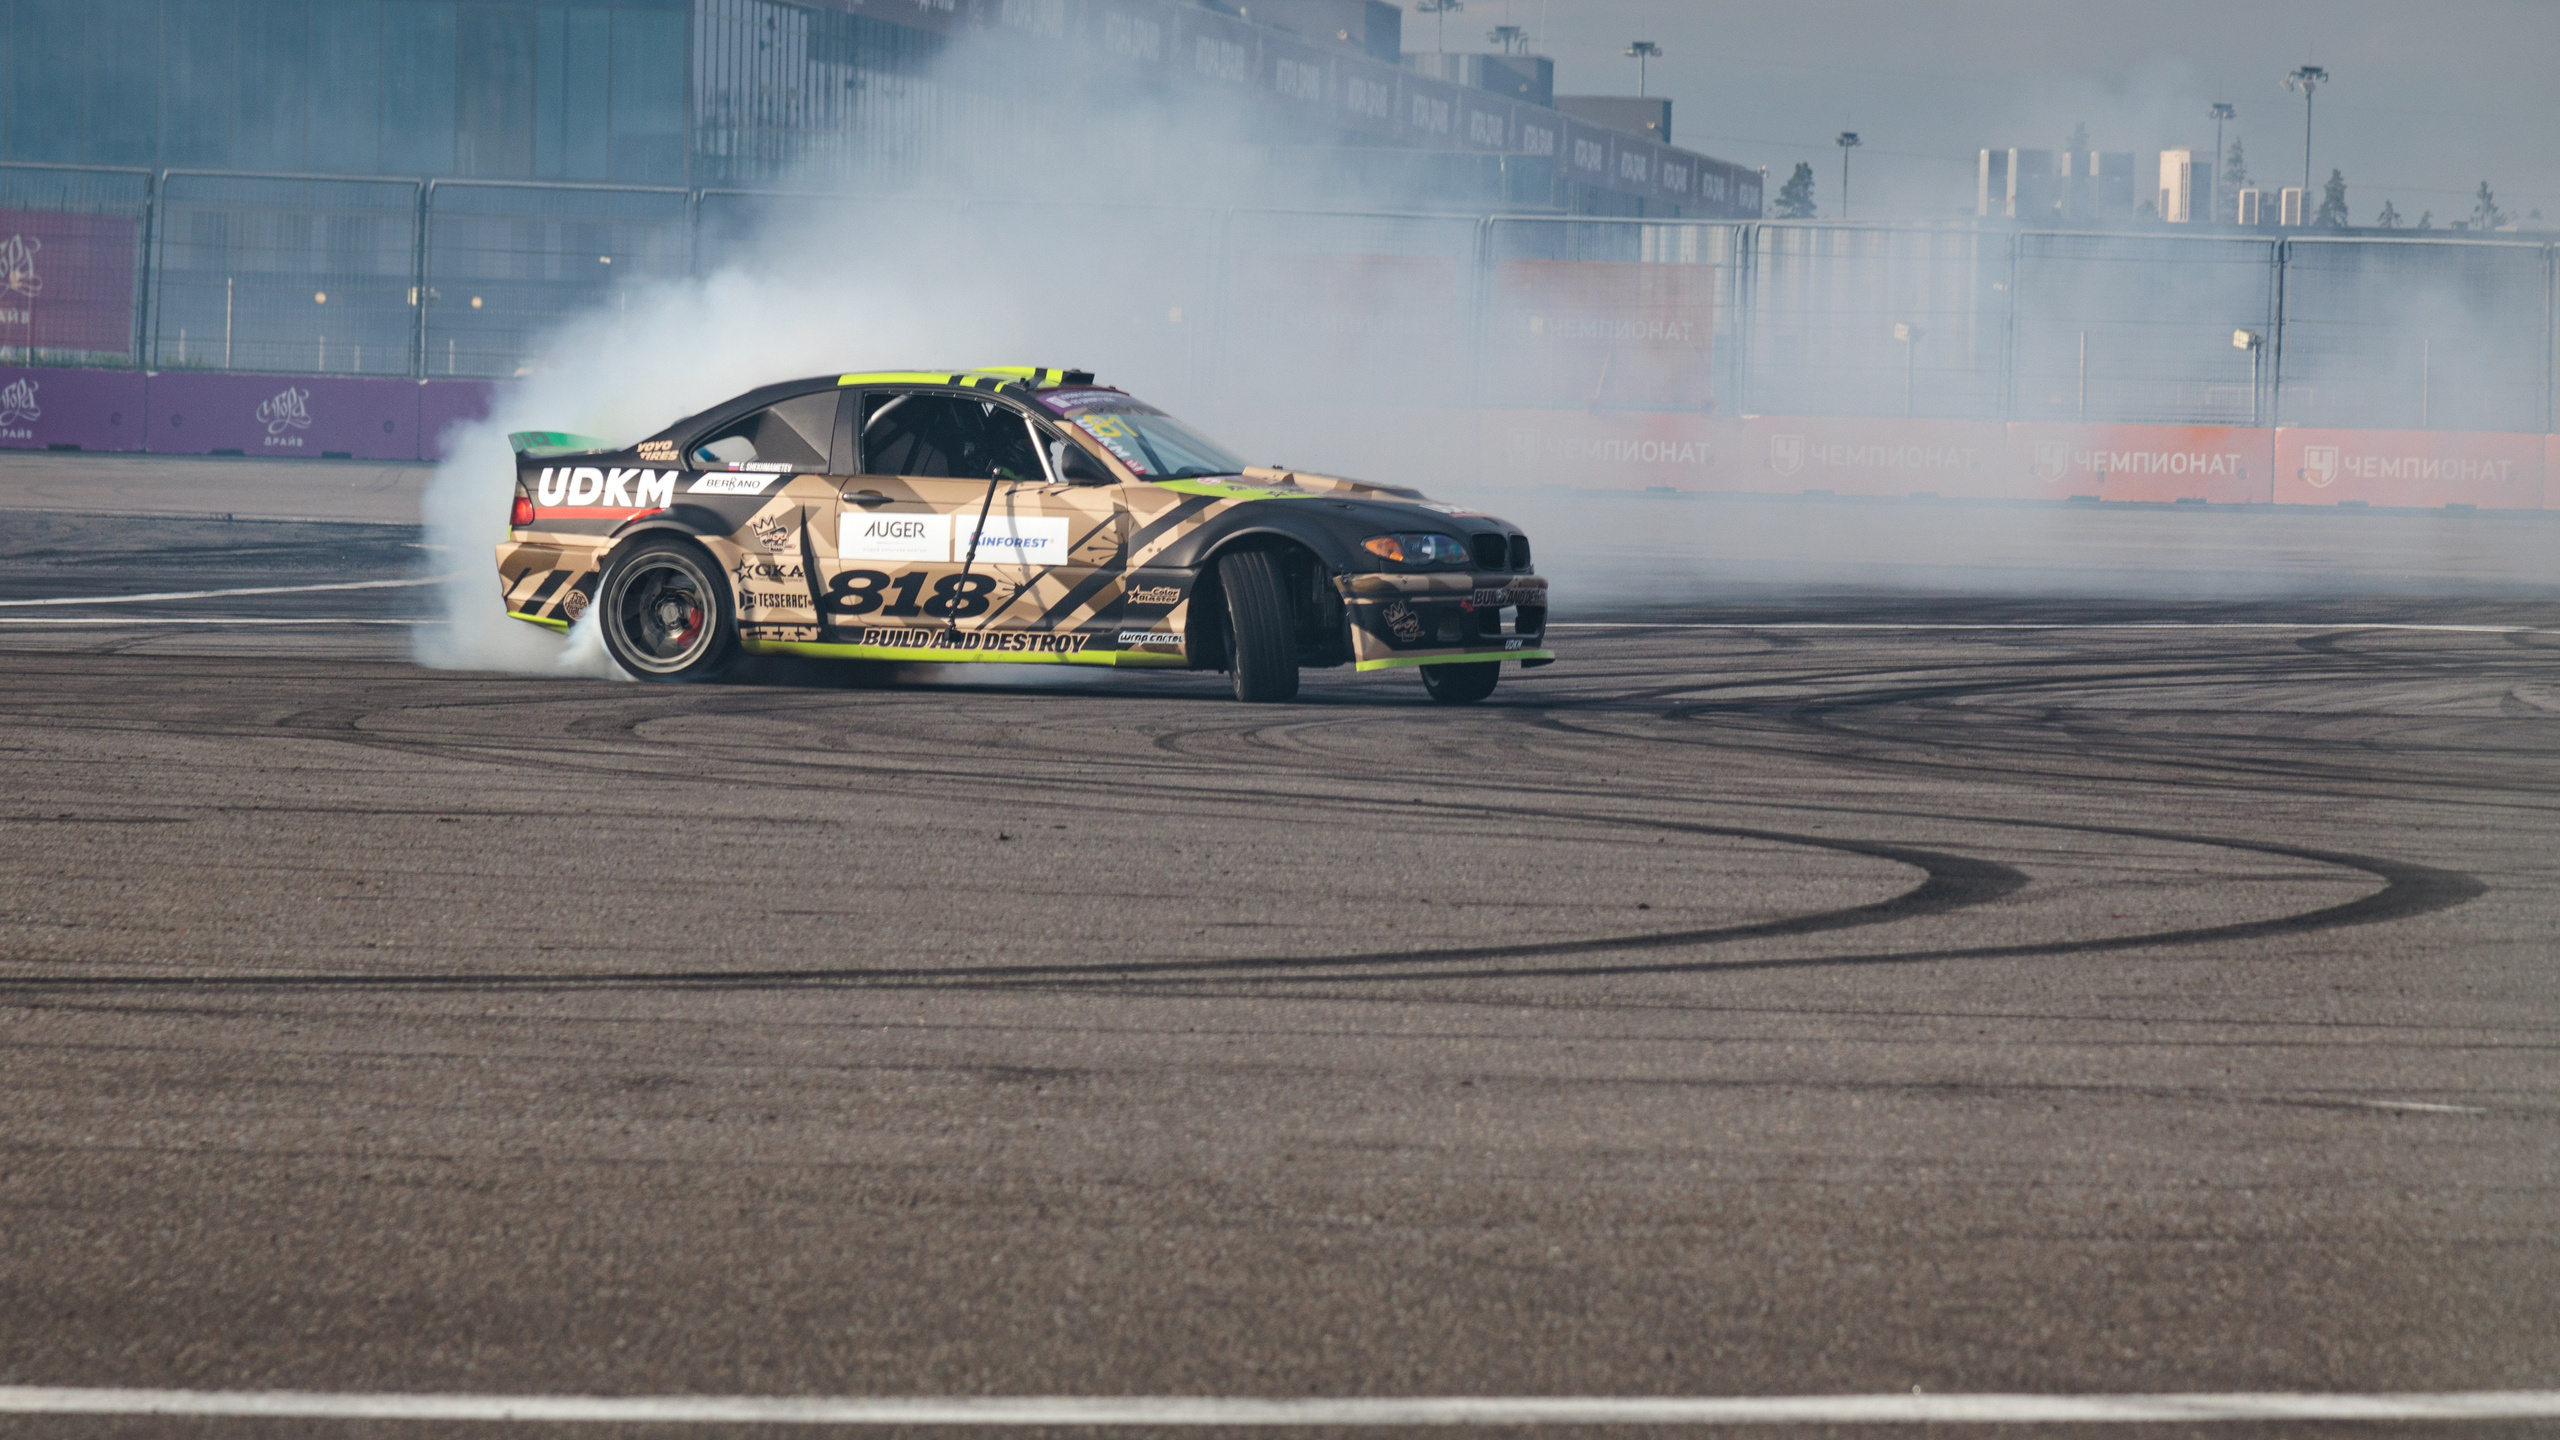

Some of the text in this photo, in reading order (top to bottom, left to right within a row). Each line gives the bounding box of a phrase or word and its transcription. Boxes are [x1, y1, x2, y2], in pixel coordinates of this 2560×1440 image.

[1545, 318, 1695, 342] ЧЕМПИОНАТ
[0, 427, 33, 440] РАЙВ
[263, 435, 304, 447] ДРАЙВ
[640, 450, 679, 461] TIRES
[1546, 438, 1711, 464] ЧЕМПИОНАТ
[1811, 444, 1977, 469] ЧЕМПИОНАТ
[2075, 450, 2241, 475] ЧЕМПИОНАТ
[2344, 456, 2512, 481] ЧЕМПИОНАТ
[538, 467, 679, 508] UDKM
[706, 477, 760, 490] BERKANO
[864, 521, 926, 538] AUGER
[759, 593, 808, 608] TESSERACT
[822, 569, 997, 619] 818
[1153, 588, 1178, 596] Color
[862, 628, 1090, 653] BUILD AND DESTROY
[1504, 639, 1524, 650] UDKM
